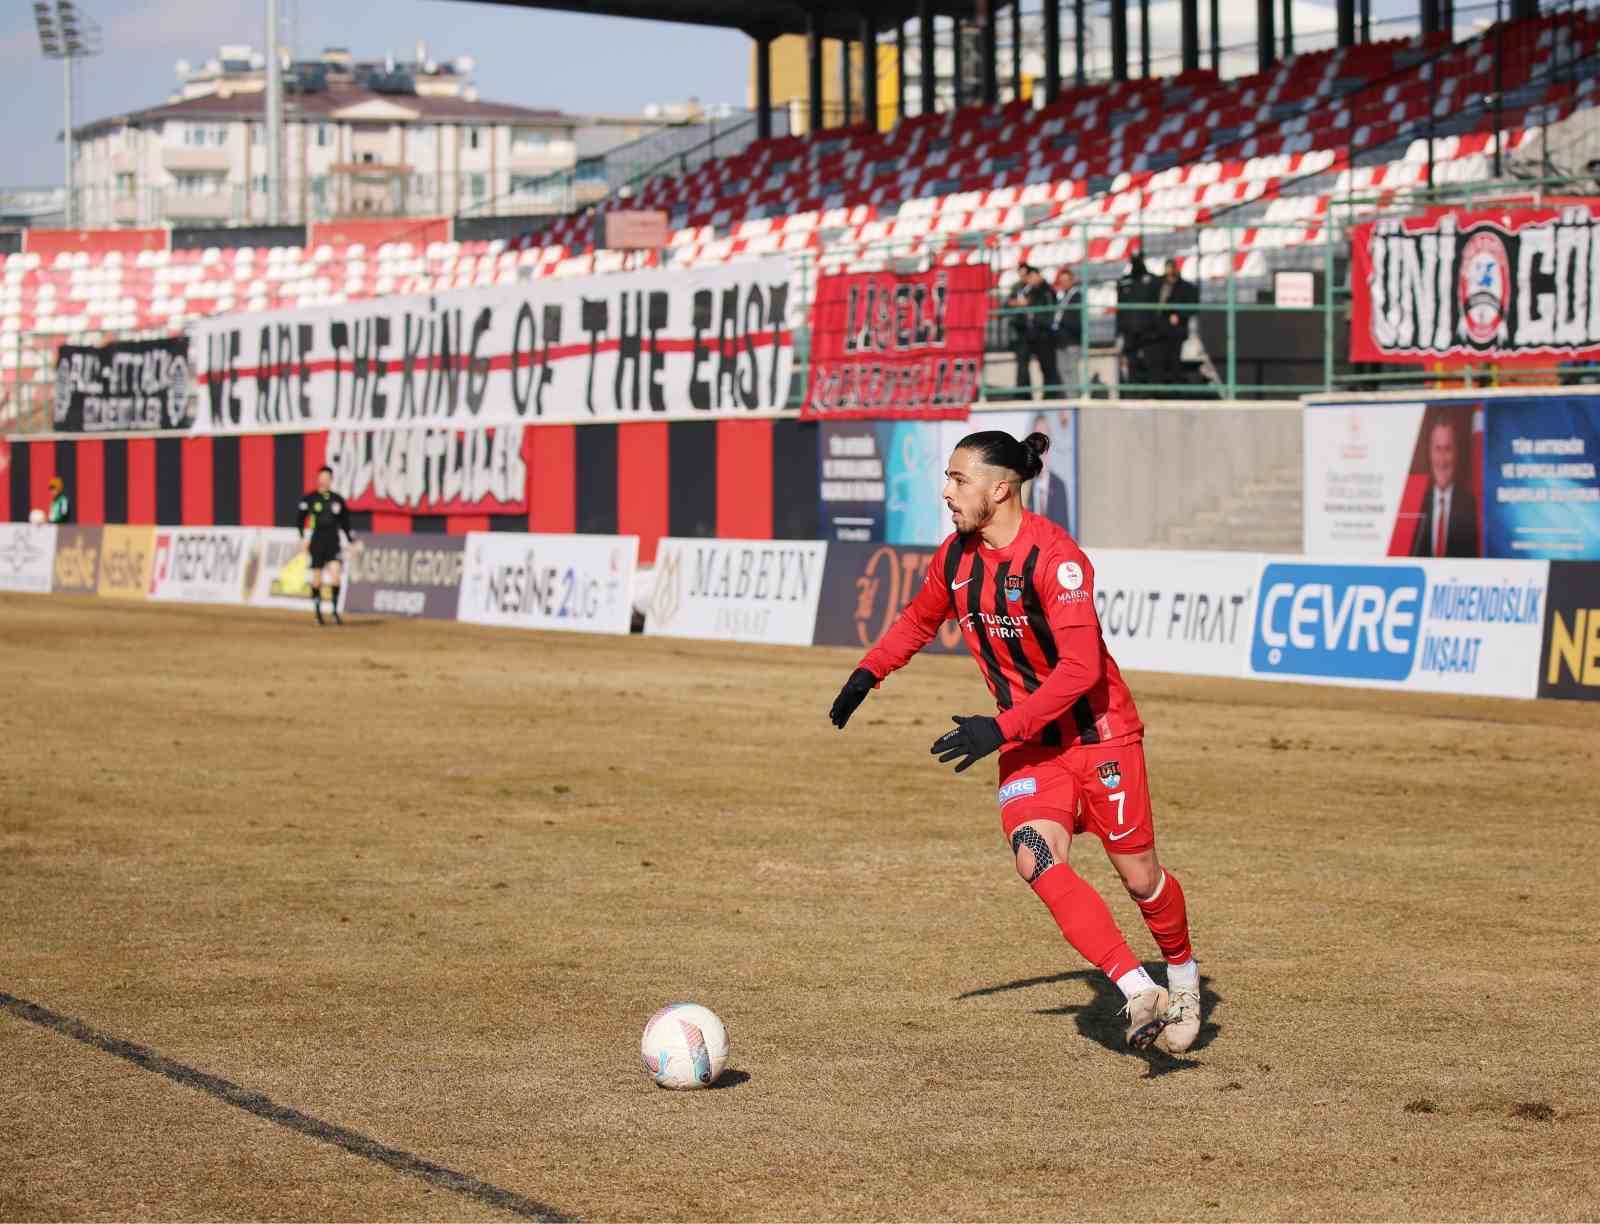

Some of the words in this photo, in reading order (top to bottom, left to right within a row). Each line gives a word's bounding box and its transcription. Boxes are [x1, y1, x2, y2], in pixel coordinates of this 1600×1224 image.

[207, 330, 241, 425] WE
[256, 323, 313, 423] ARE
[330, 316, 390, 419] THE
[512, 301, 562, 416] OF
[581, 289, 669, 414] THE
[689, 281, 789, 411] EAST
[175, 534, 243, 584] REFORM
[687, 548, 816, 602] MABEYN
[978, 611, 1029, 626] TURGUT
[1260, 580, 1420, 666] ÇEVRE
[1429, 577, 1545, 625] MÜHENDİSLİK
[989, 626, 1025, 639] FIRAT
[1419, 628, 1483, 676] İNŞAAT
[1107, 790, 1126, 825] 7
